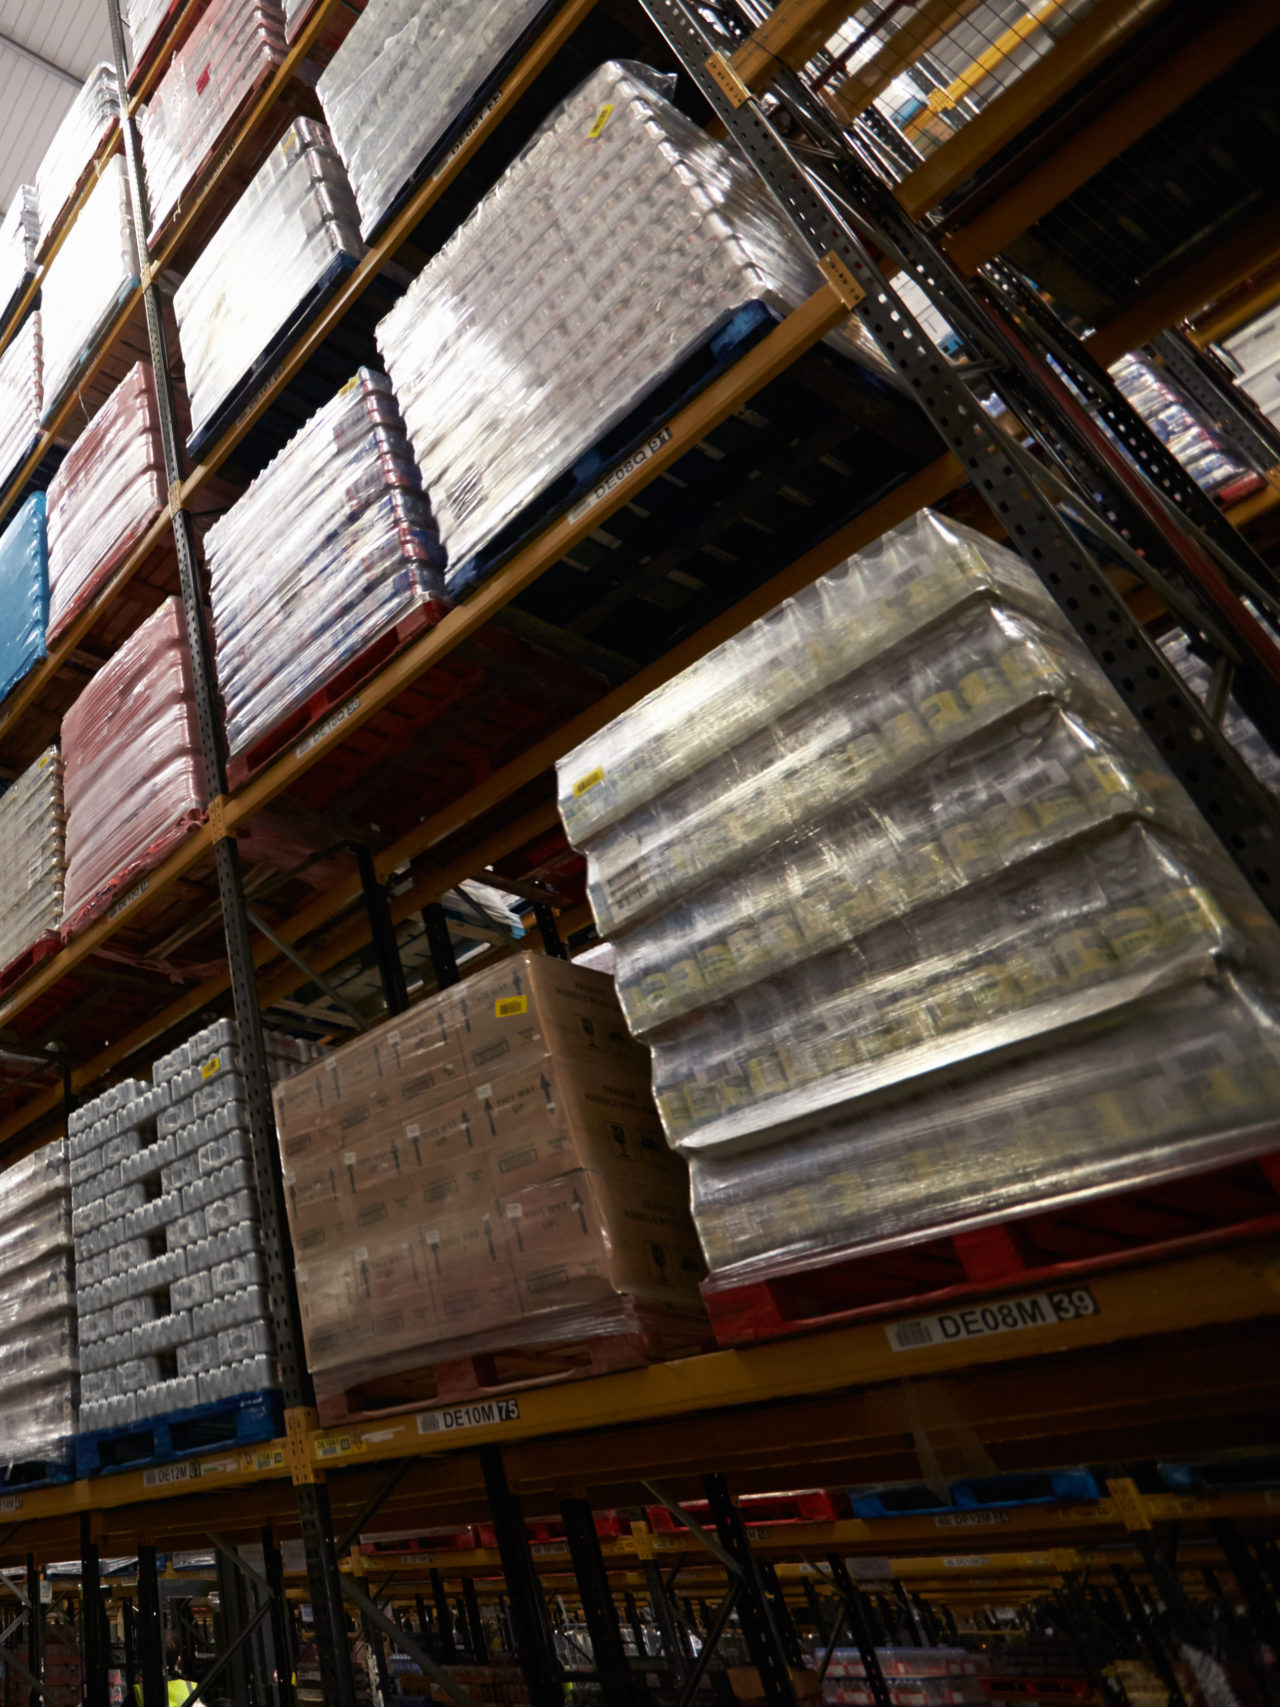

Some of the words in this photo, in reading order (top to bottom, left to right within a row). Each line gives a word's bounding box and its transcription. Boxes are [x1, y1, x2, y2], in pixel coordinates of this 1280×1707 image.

[594, 451, 647, 499] DE08Q
[517, 1086, 536, 1100] WAY
[938, 1298, 1047, 1339] DE08M
[1054, 1289, 1096, 1321] 39
[442, 1402, 495, 1429] DE10M
[497, 1398, 520, 1421] 75
[158, 1463, 188, 1482] DE12M
